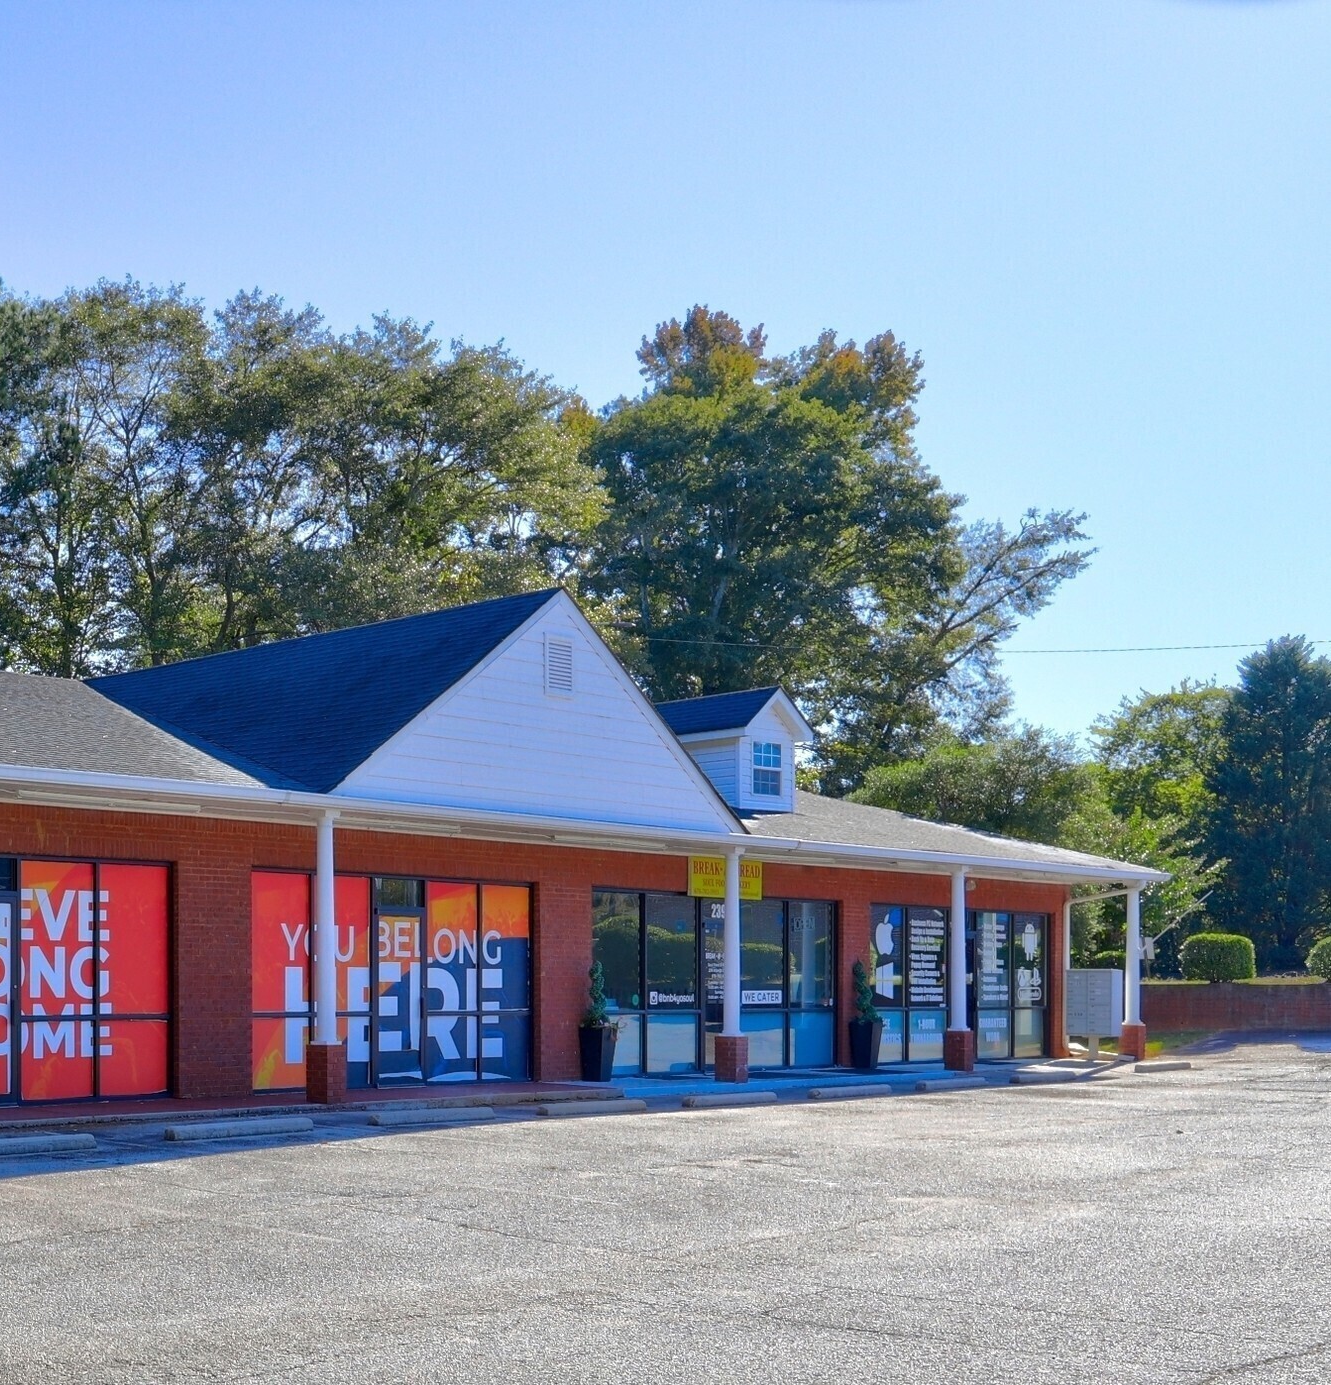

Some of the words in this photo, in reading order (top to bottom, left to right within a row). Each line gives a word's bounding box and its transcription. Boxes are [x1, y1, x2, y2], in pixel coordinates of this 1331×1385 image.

[368, 922, 502, 965] BELONG
[285, 962, 503, 1064] HERE
[743, 993, 755, 1002] WE
[757, 993, 779, 1002] CATER
